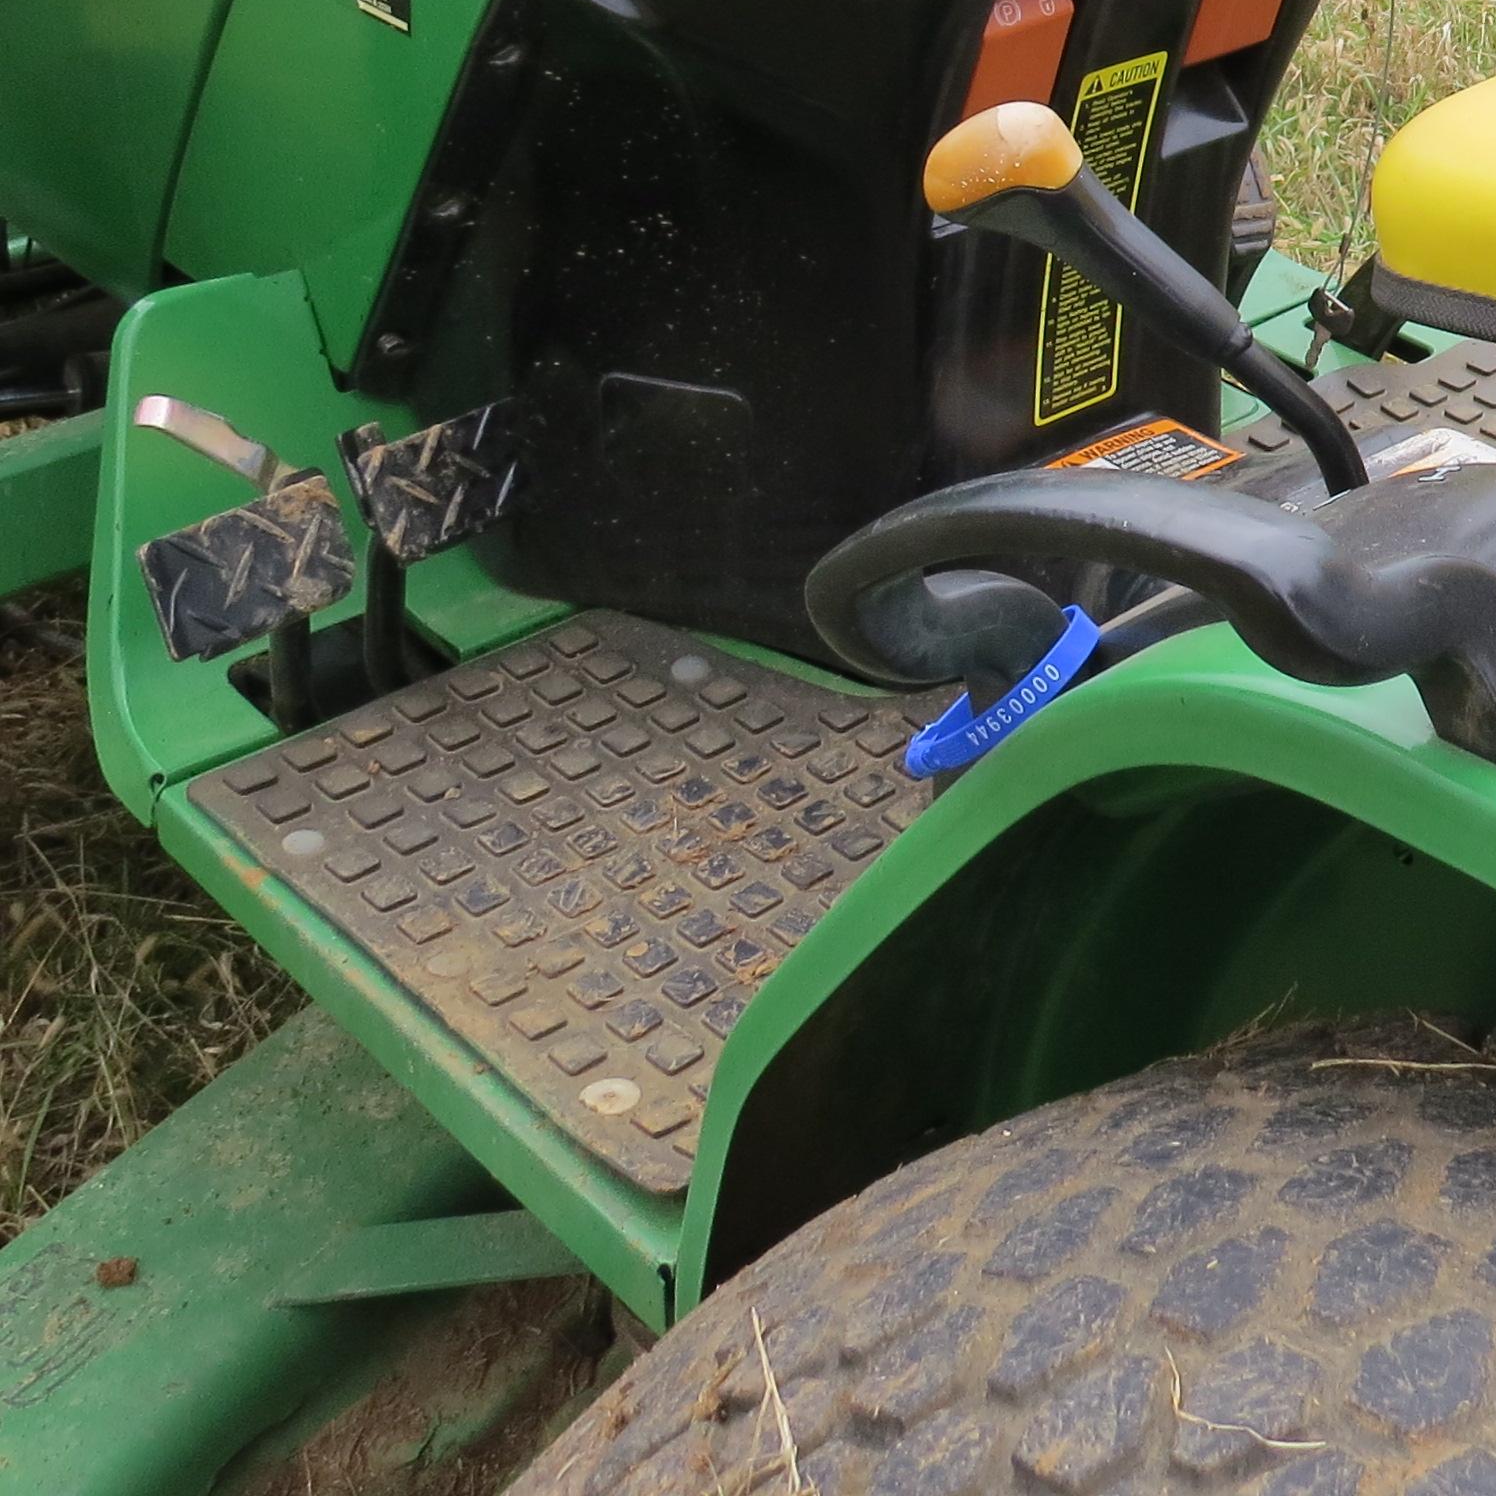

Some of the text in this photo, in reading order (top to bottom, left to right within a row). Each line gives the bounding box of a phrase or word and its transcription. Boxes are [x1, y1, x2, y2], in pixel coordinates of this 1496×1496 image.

[1108, 58, 1161, 88] CAUTION
[1080, 426, 1156, 461] WARNING
[965, 662, 1061, 747] 00003944
